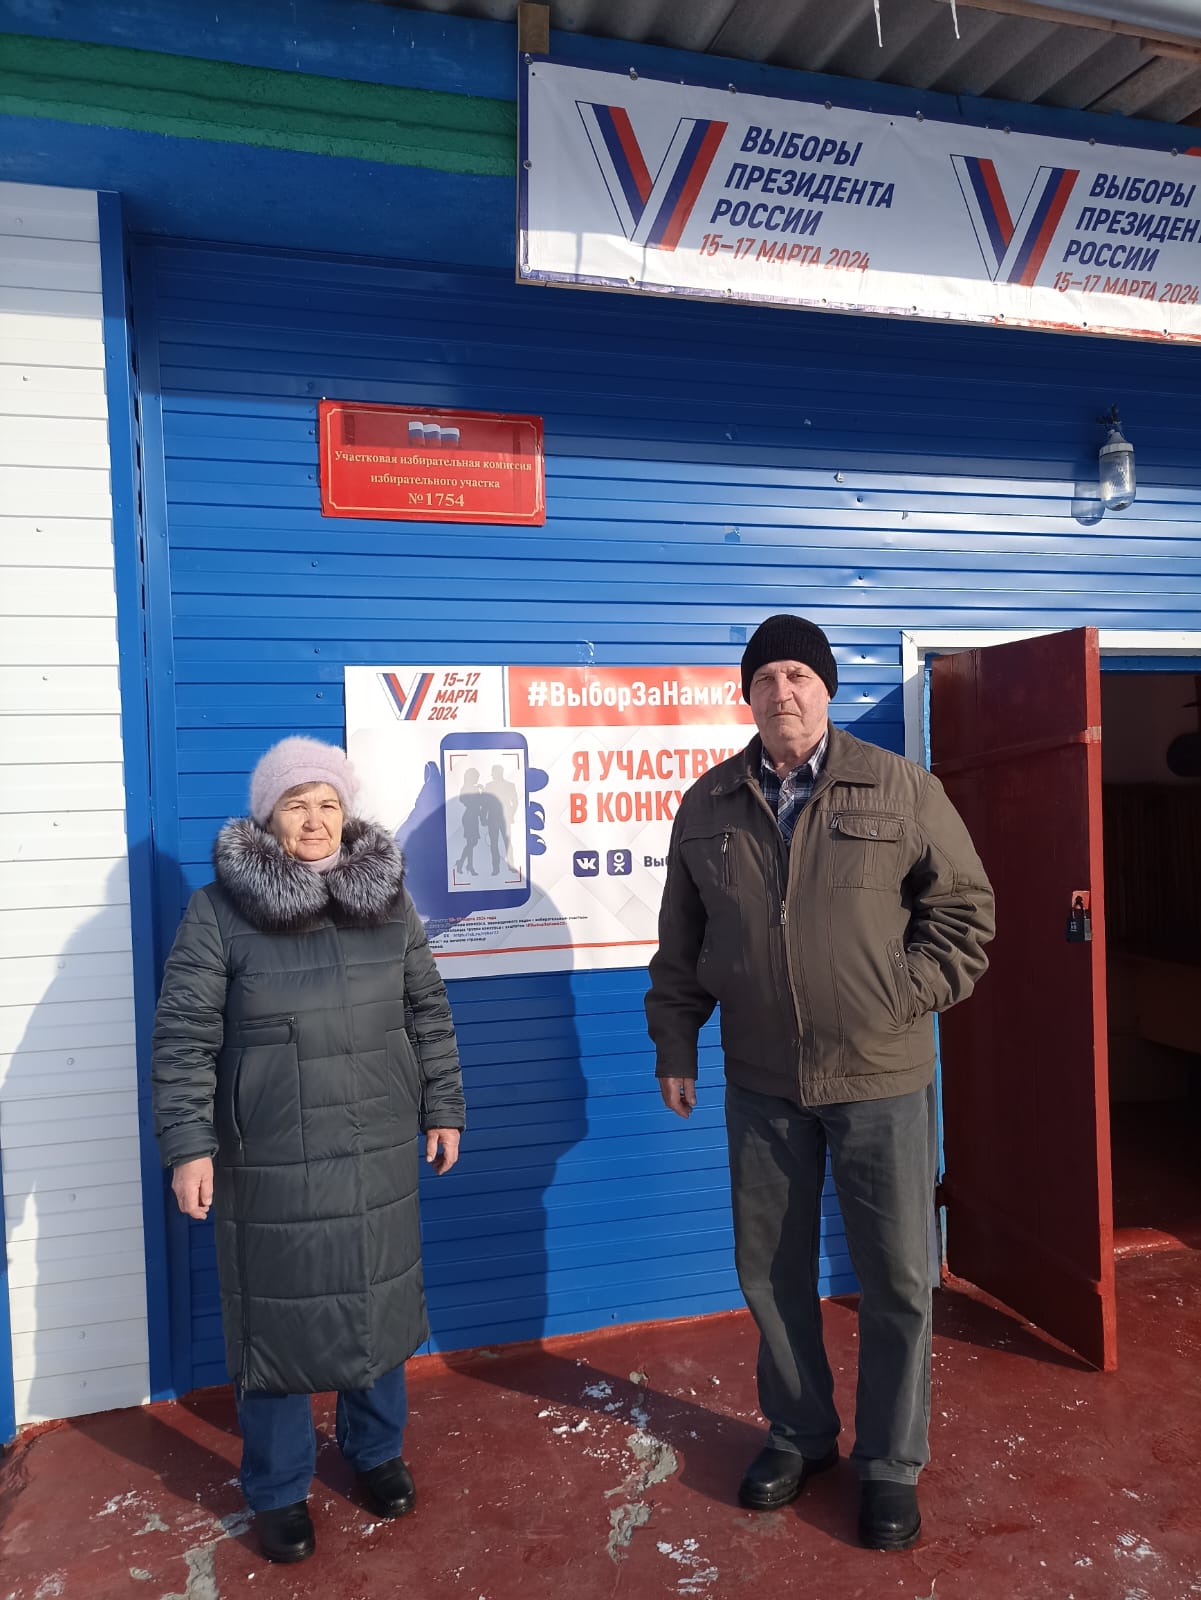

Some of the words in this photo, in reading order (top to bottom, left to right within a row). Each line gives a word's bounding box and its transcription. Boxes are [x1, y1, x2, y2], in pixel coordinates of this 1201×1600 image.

[740, 125, 863, 167] ВЫБОРЫ
[724, 162, 895, 209] ПРЕЗИДЕНТА
[1089, 173, 1196, 208] ВЫБОРЫ
[709, 198, 823, 236] РОССИИ
[1075, 206, 1201, 244] ПРЕЗИДЕН
[755, 239, 822, 267] МАРТА
[823, 247, 870, 273] 2024
[1062, 239, 1160, 272] РОССИИ
[1102, 276, 1158, 301] МАРТА
[1158, 282, 1200, 304] 2024
[335, 450, 398, 465] Участковая
[400, 455, 480, 469] избирательная
[483, 460, 532, 471] комиссия
[371, 473, 457, 487] избирательного
[460, 478, 500, 489] участка
[434, 689, 479, 703] МАРТА
[427, 706, 459, 721] 2024
[572, 751, 590, 782] Я
[570, 793, 588, 824] В
